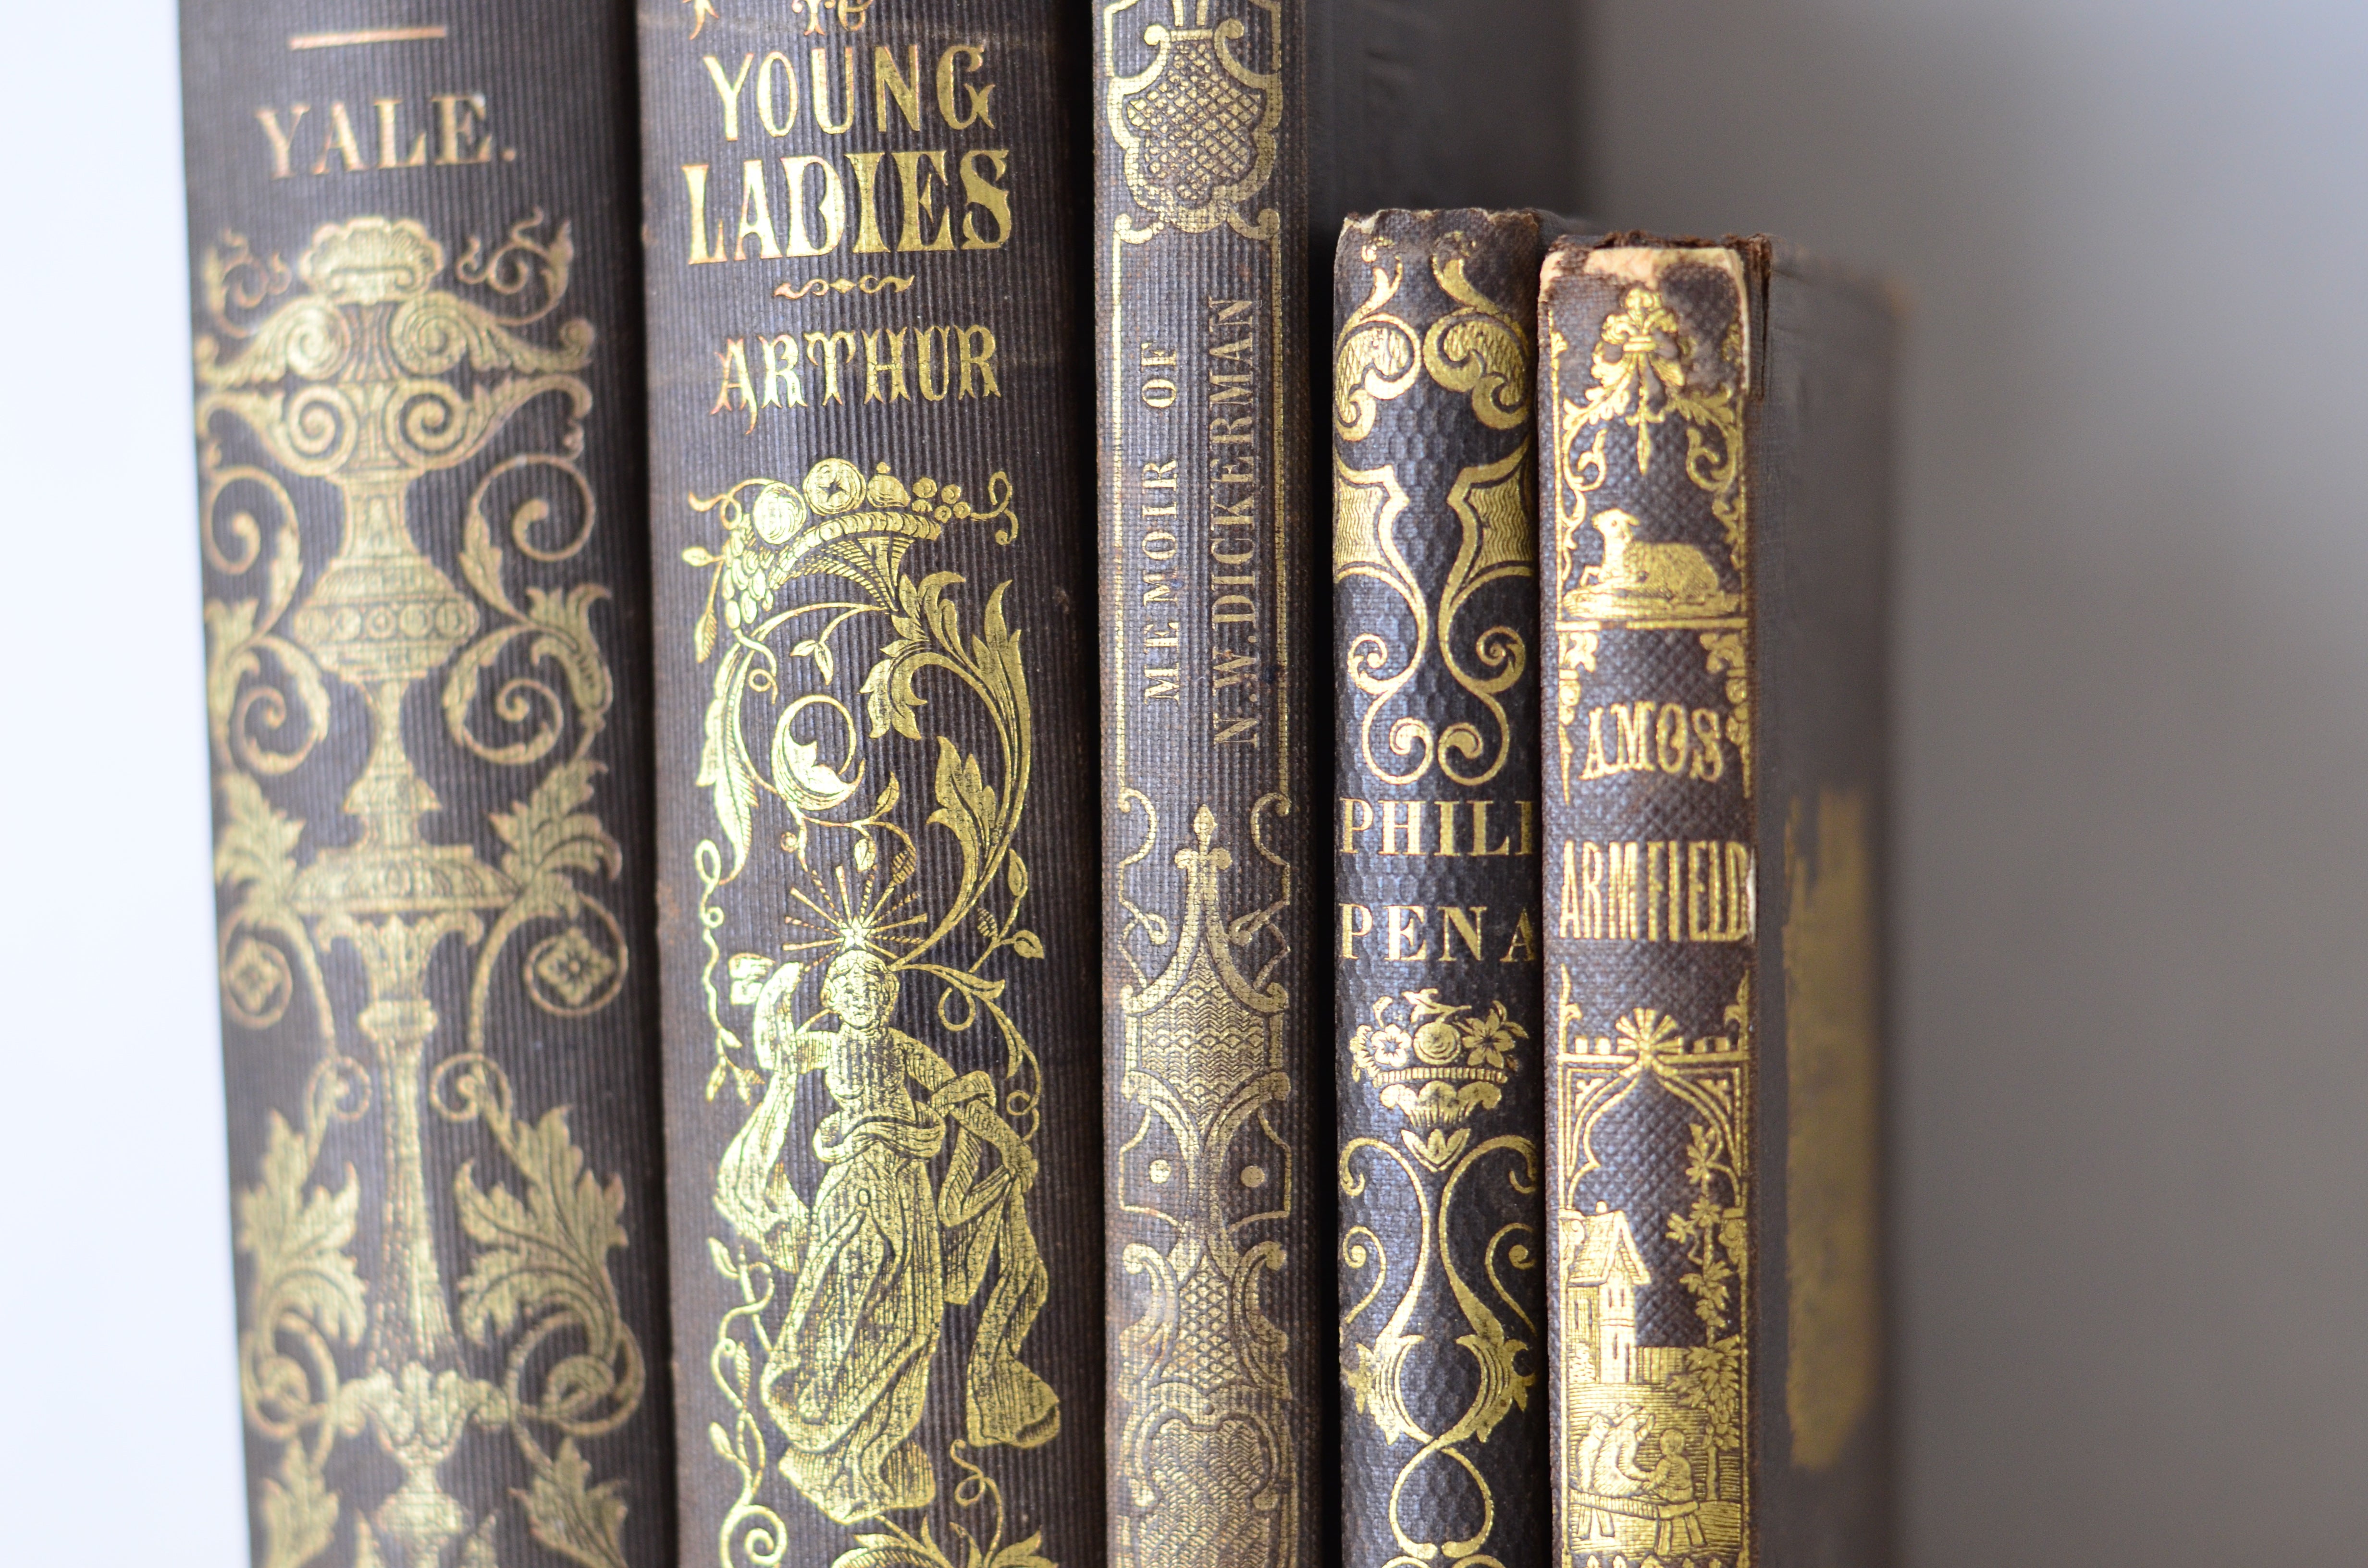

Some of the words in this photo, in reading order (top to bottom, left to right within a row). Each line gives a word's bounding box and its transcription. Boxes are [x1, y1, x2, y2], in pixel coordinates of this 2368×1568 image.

[255, 93, 517, 180] YALE.
[703, 44, 996, 142] YOUNG
[681, 149, 1011, 265] LADIES
[710, 324, 1001, 435] ARTHUR
[1141, 342, 1178, 408] OF
[1141, 458, 1180, 705] MEMOIR
[1578, 700, 1724, 783] AMOS
[1339, 903, 1537, 962] PENA
[1558, 839, 1750, 943] ARMFIELD
